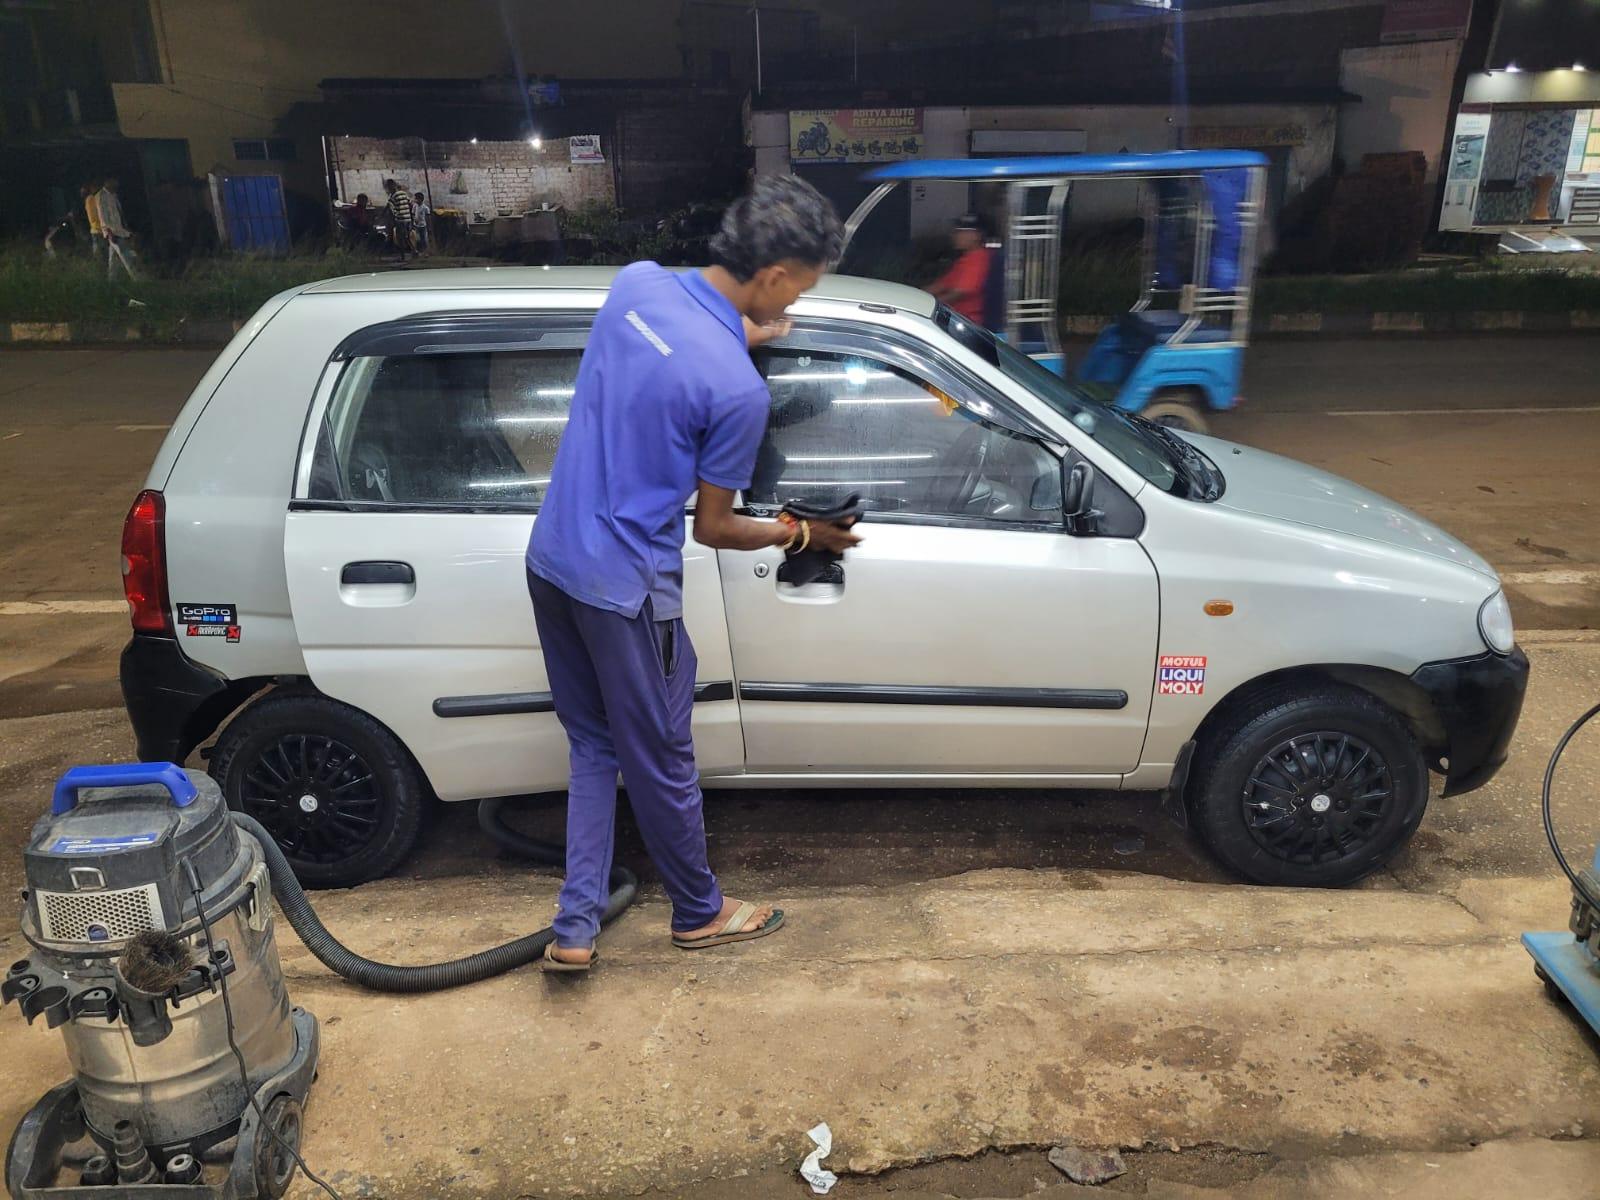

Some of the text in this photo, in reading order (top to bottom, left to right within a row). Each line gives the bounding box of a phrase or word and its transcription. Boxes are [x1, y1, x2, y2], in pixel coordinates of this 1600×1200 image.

[889, 107, 916, 117] AUTO
[852, 116, 916, 128] REPAIRING
[181, 606, 231, 616] GoPro
[1161, 656, 1205, 667] MOTUL
[1161, 668, 1204, 682] LIQUI
[1159, 681, 1204, 694] MOLY
